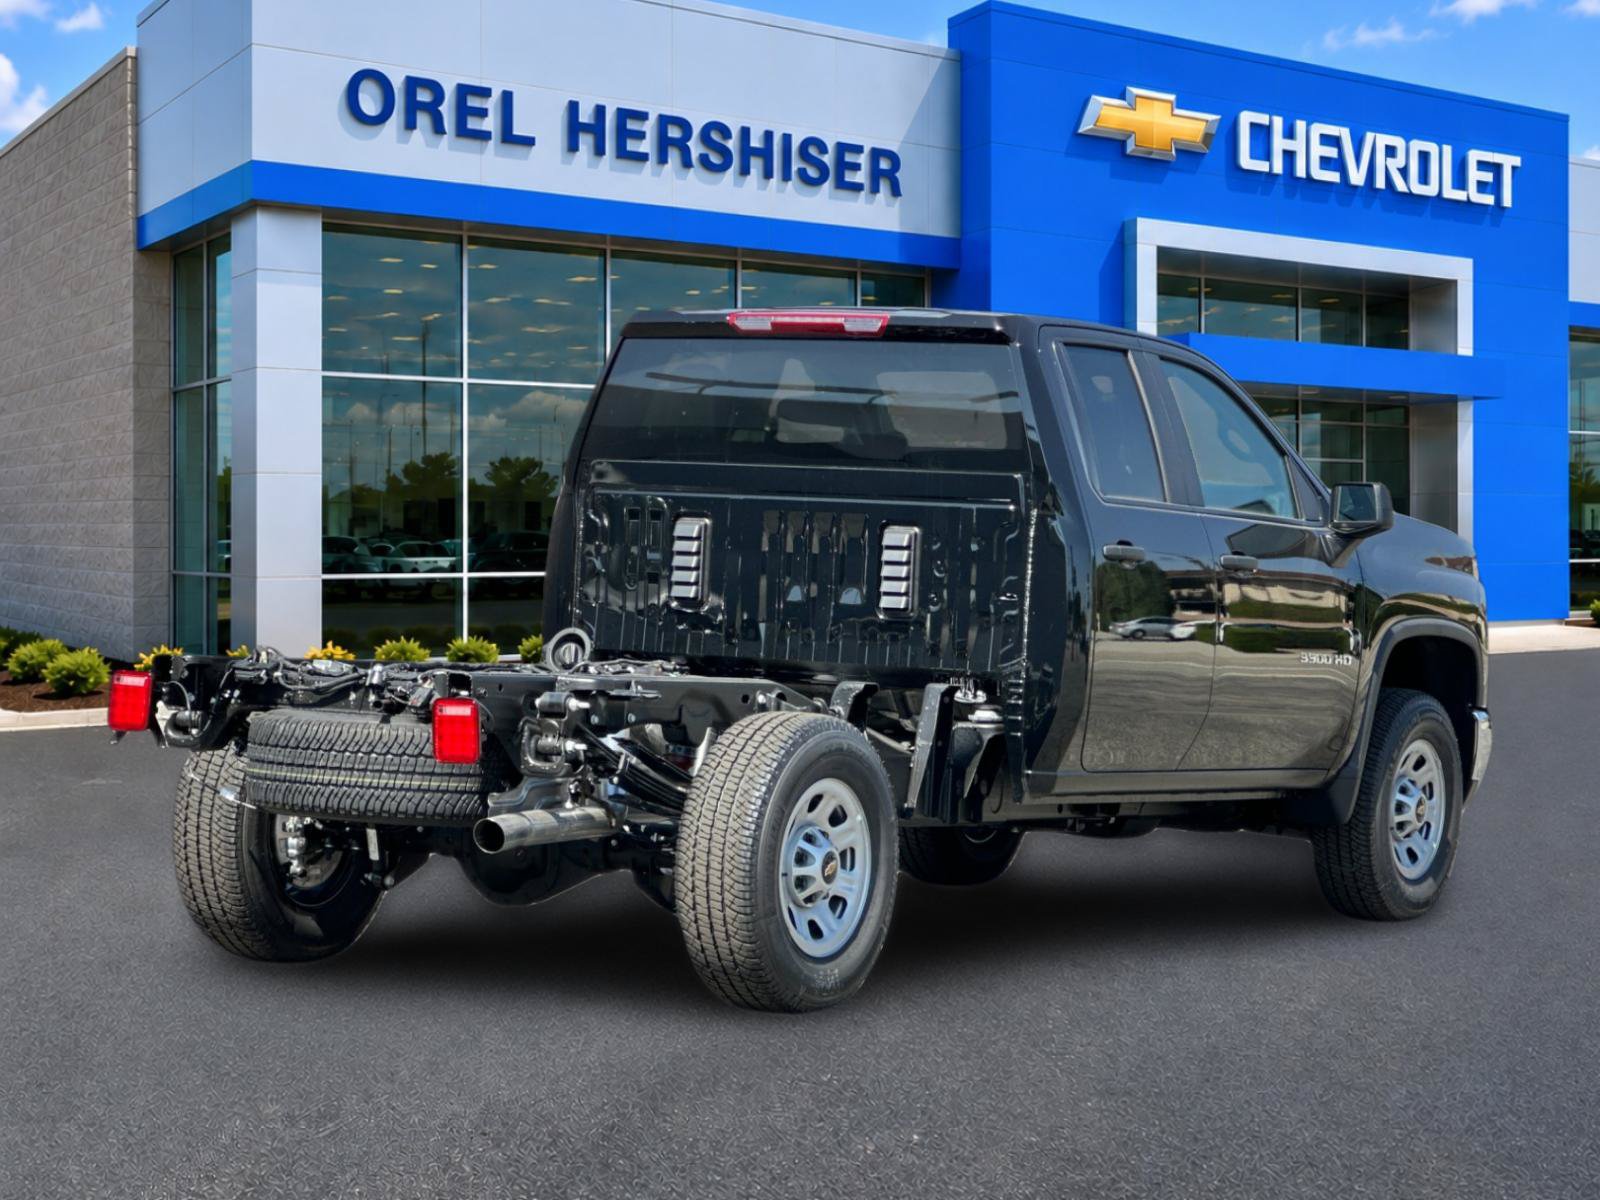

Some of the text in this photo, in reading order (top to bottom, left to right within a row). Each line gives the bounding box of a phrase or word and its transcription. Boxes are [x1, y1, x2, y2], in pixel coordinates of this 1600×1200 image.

[346, 68, 902, 198] OREL HERSHISER
[1237, 110, 1522, 208] CHEVROLET
[1334, 654, 1352, 665] HD
